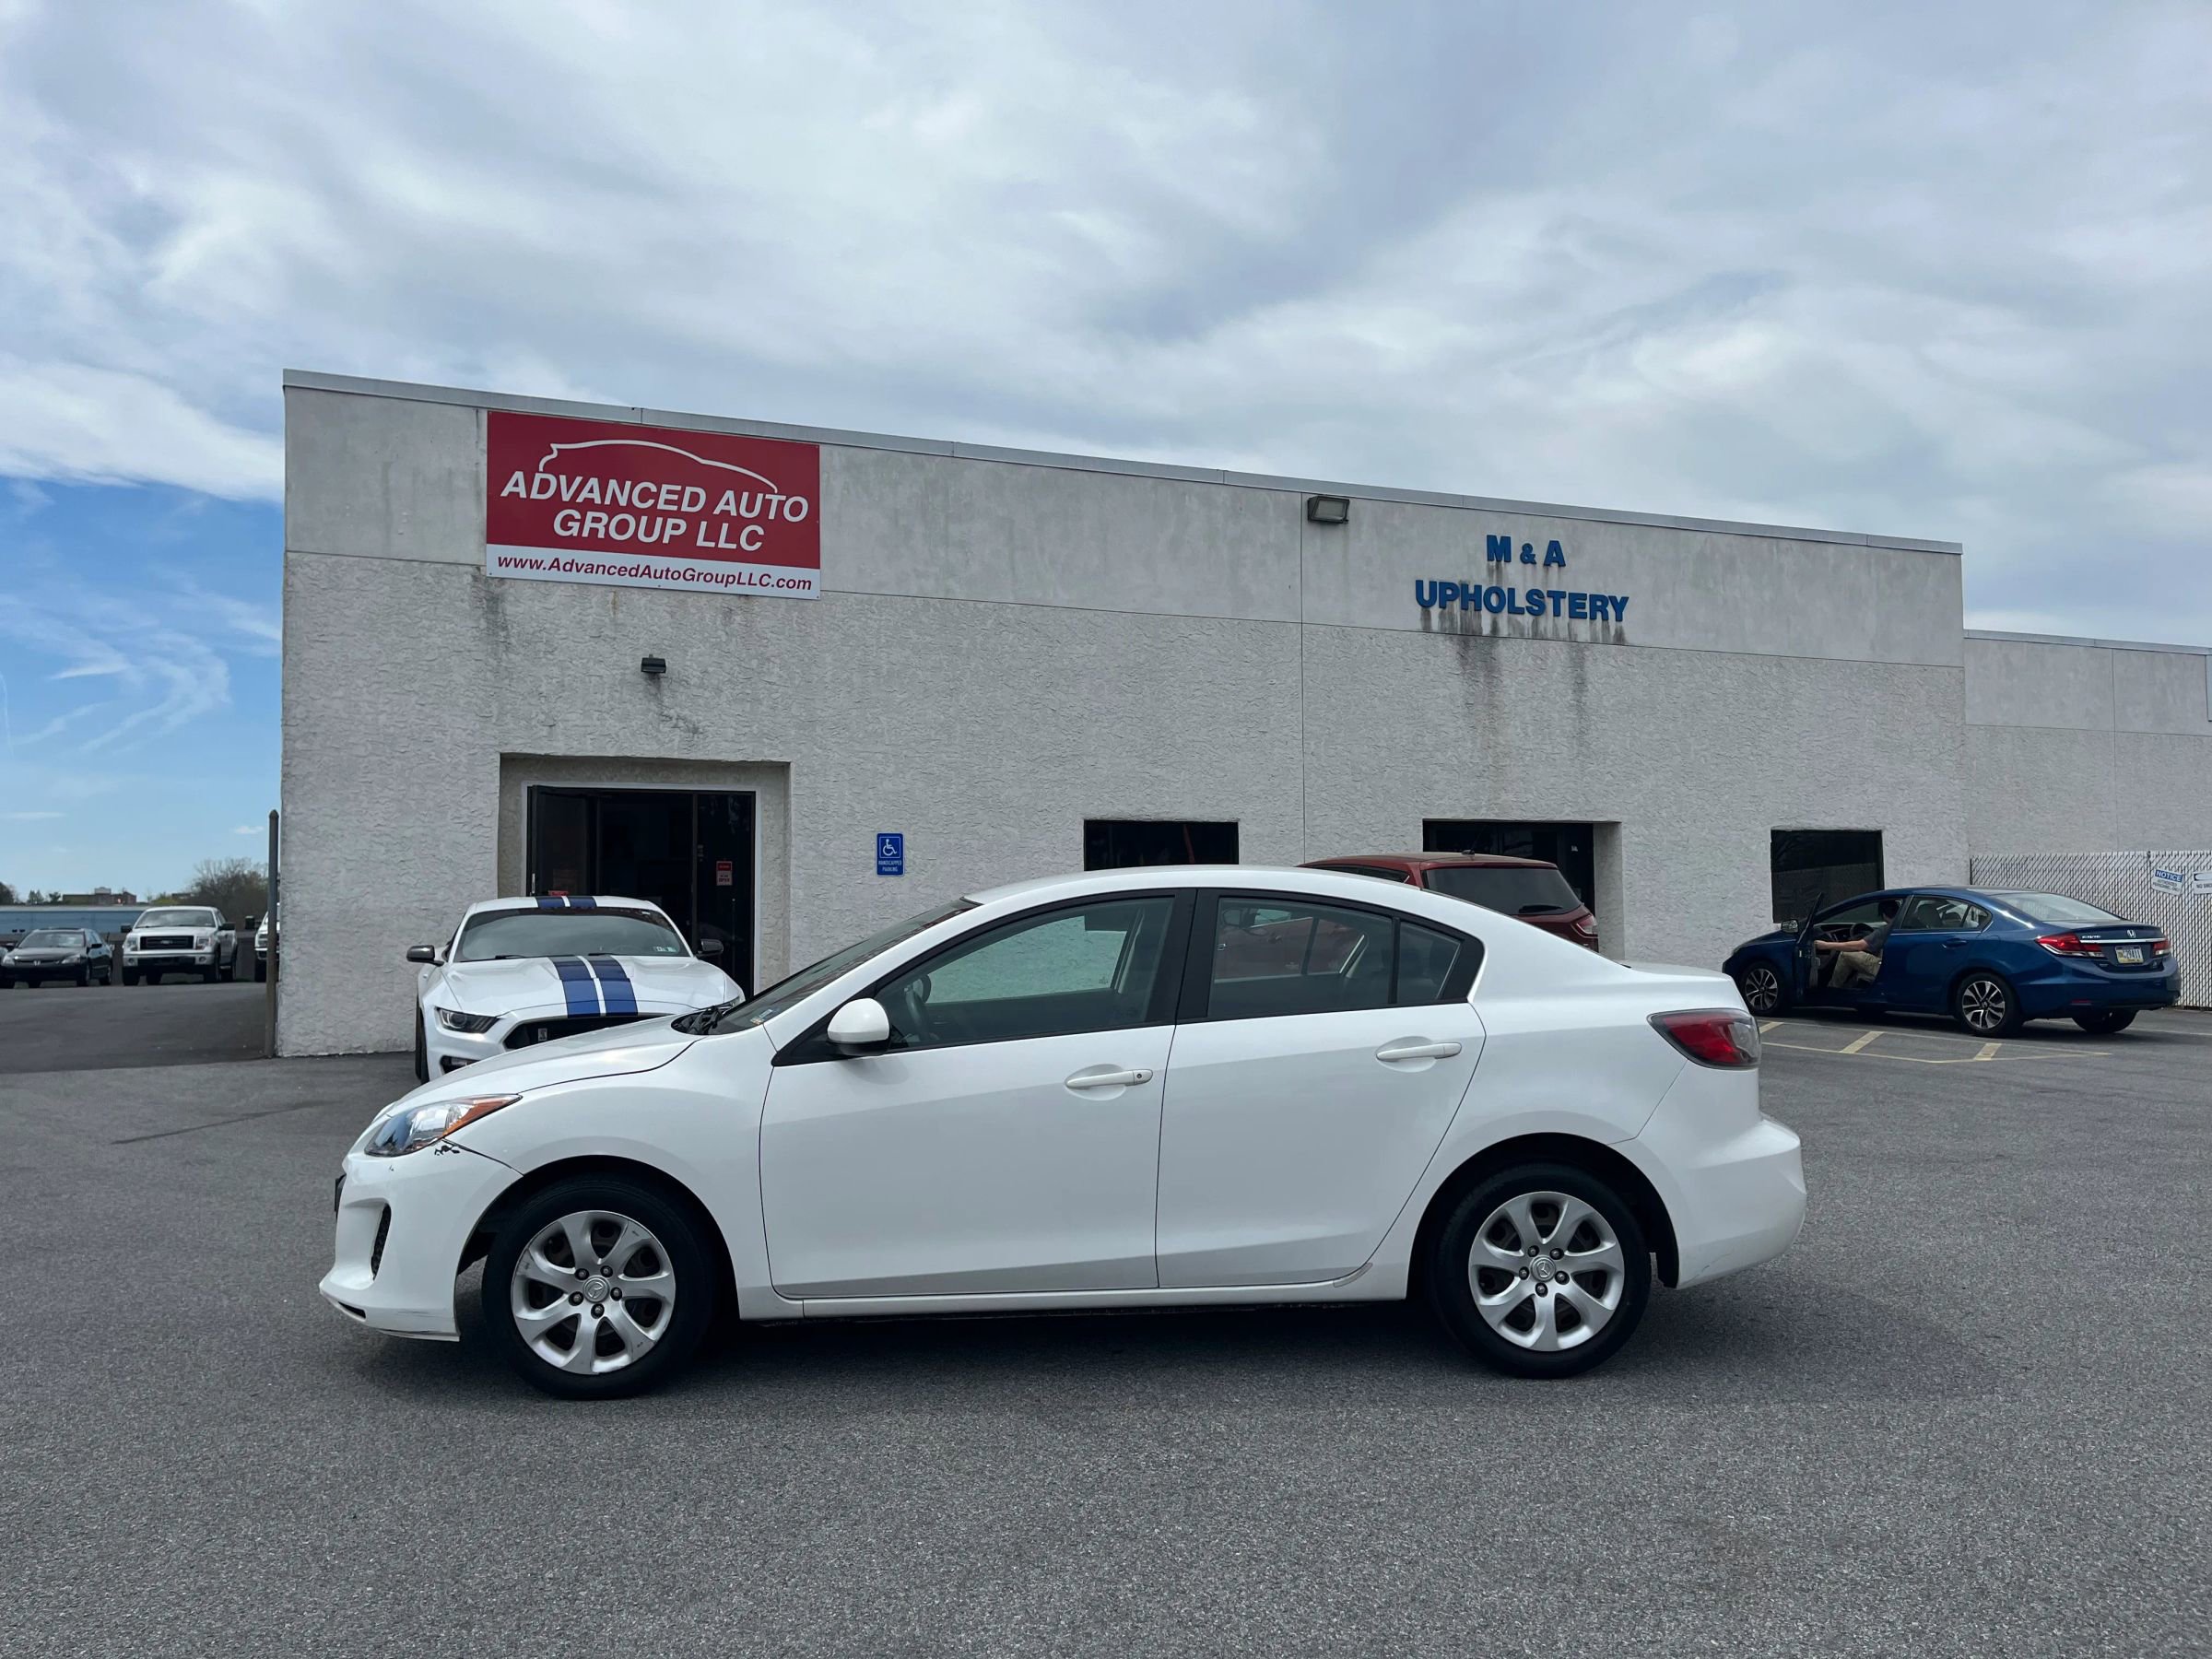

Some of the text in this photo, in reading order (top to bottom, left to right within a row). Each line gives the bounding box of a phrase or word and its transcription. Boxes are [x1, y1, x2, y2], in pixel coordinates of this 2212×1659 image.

[500, 471, 808, 522] ADVANCED AUTO
[553, 509, 764, 551] GROUP LLC
[1487, 535, 1566, 567] M & A
[497, 555, 812, 591] www.AdvancedAutoGroupLLC.com
[1415, 579, 1630, 622] UPHOLSTERY
[2156, 870, 2183, 882] NOTICE
